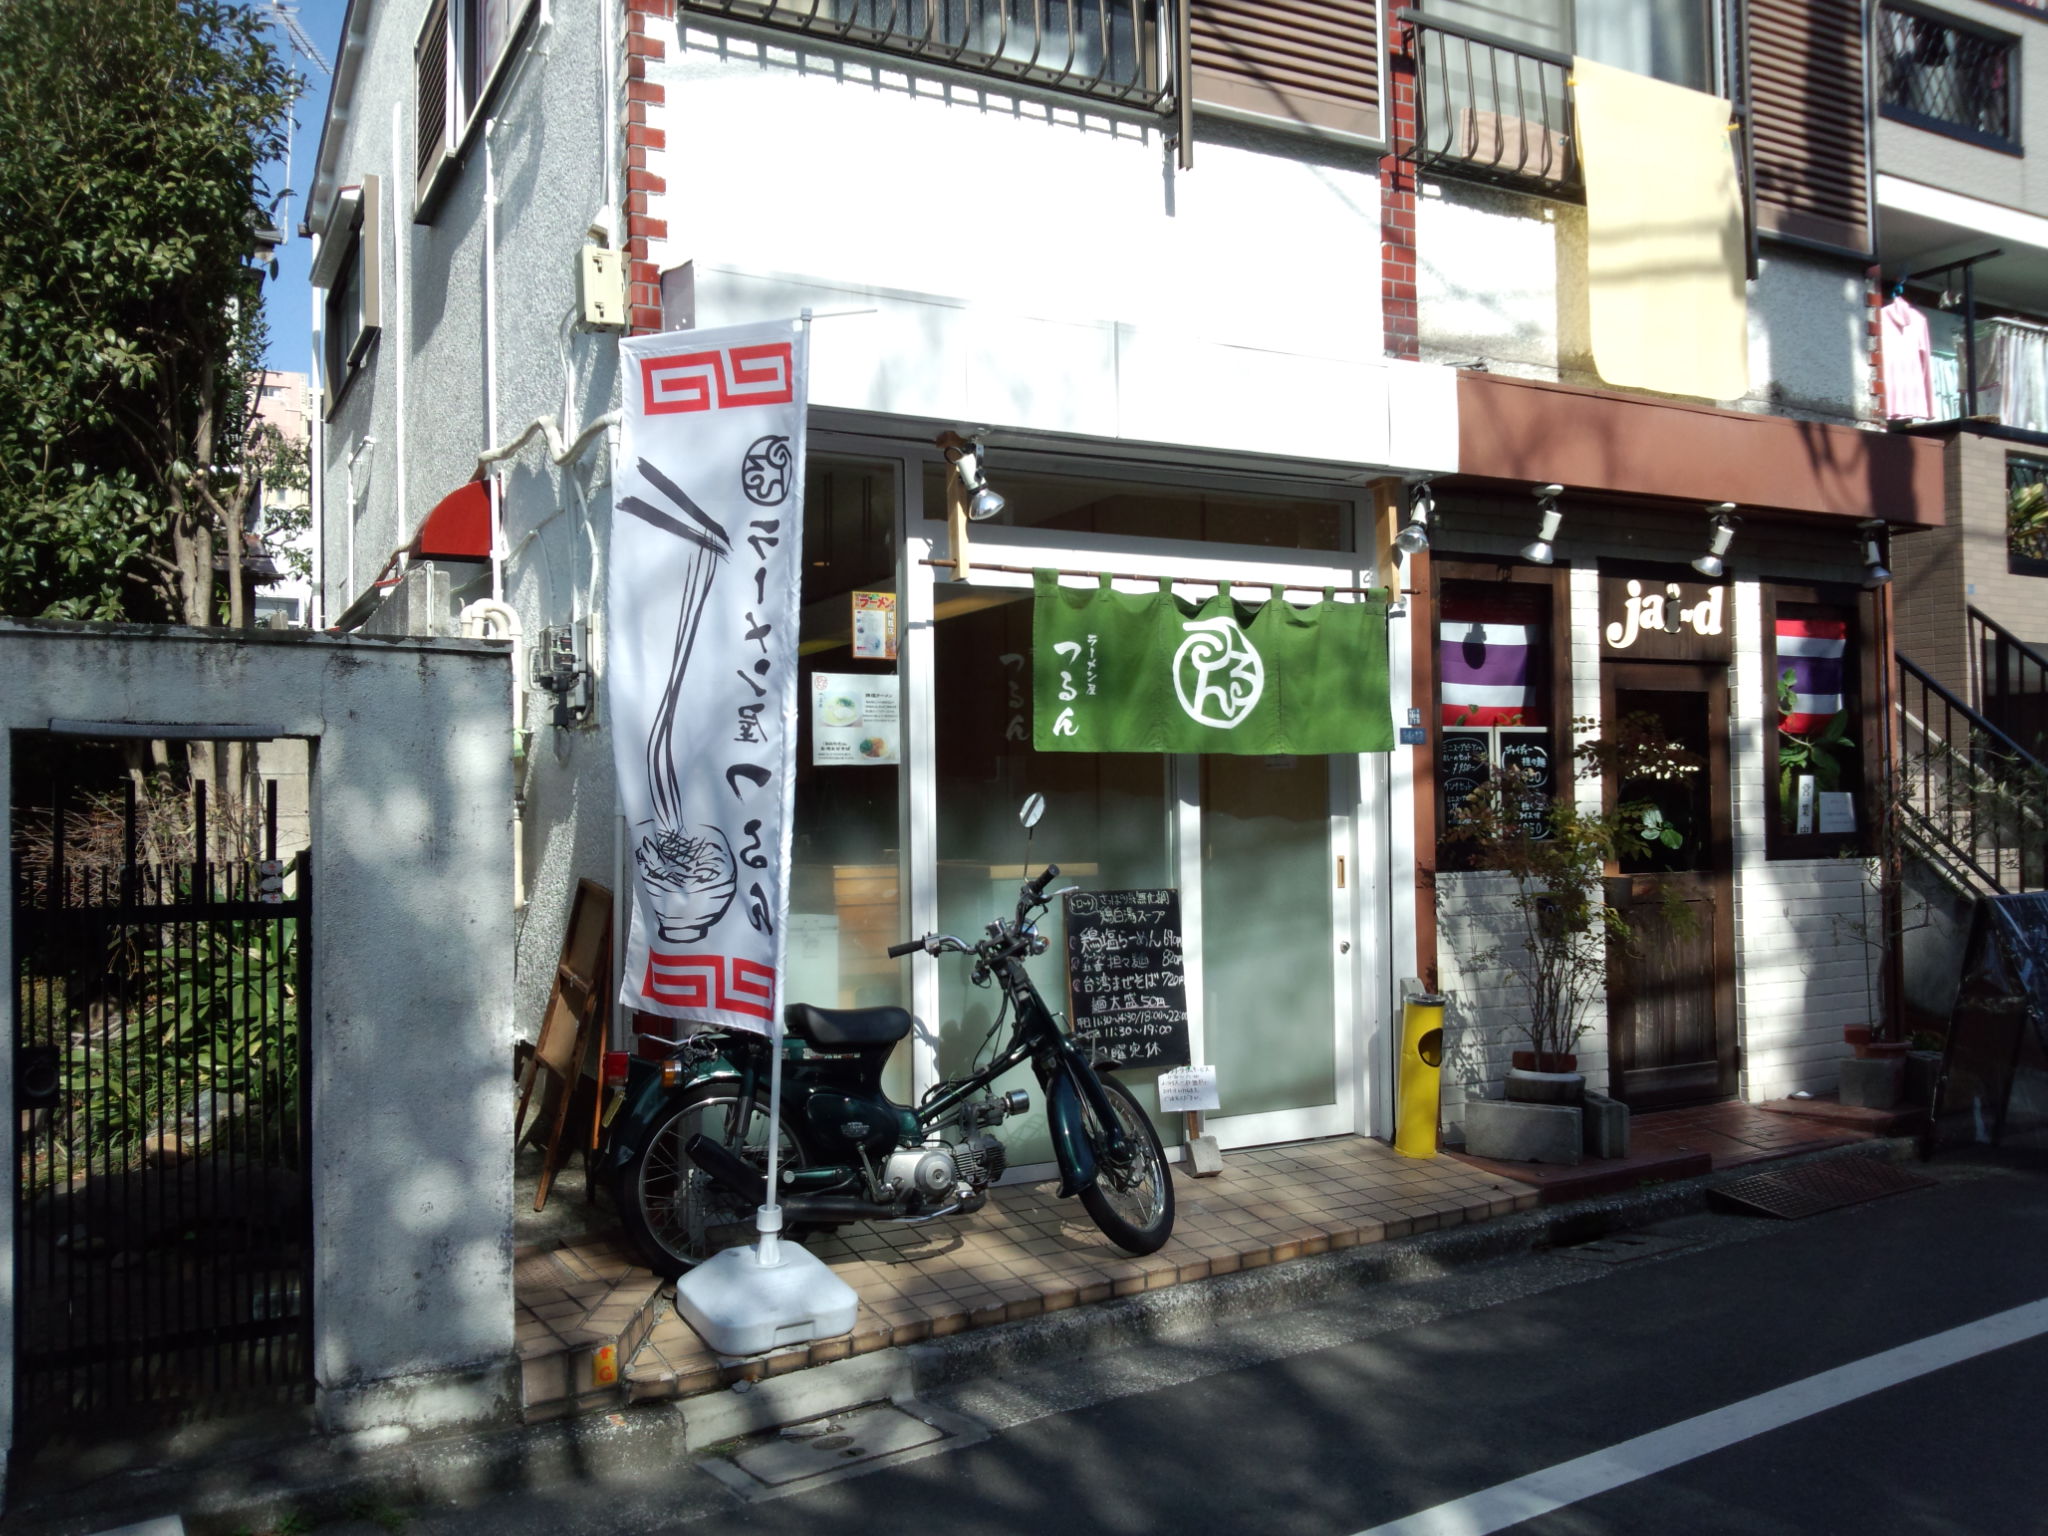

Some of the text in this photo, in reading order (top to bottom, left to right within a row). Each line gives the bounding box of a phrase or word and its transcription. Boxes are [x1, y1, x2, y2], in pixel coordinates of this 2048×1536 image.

[1606, 579, 1723, 649] jai-d
[1086, 634, 1098, 696] ラーメン屋
[999, 653, 1029, 741] つるん
[1052, 641, 1081, 737] つるん
[1099, 907, 1165, 925] 鶏白湯スープ
[1080, 927, 1161, 954] 鶏塩らーめん
[1083, 972, 1159, 992] 台湾まぜそば
[1141, 995, 1166, 1009] 50円
